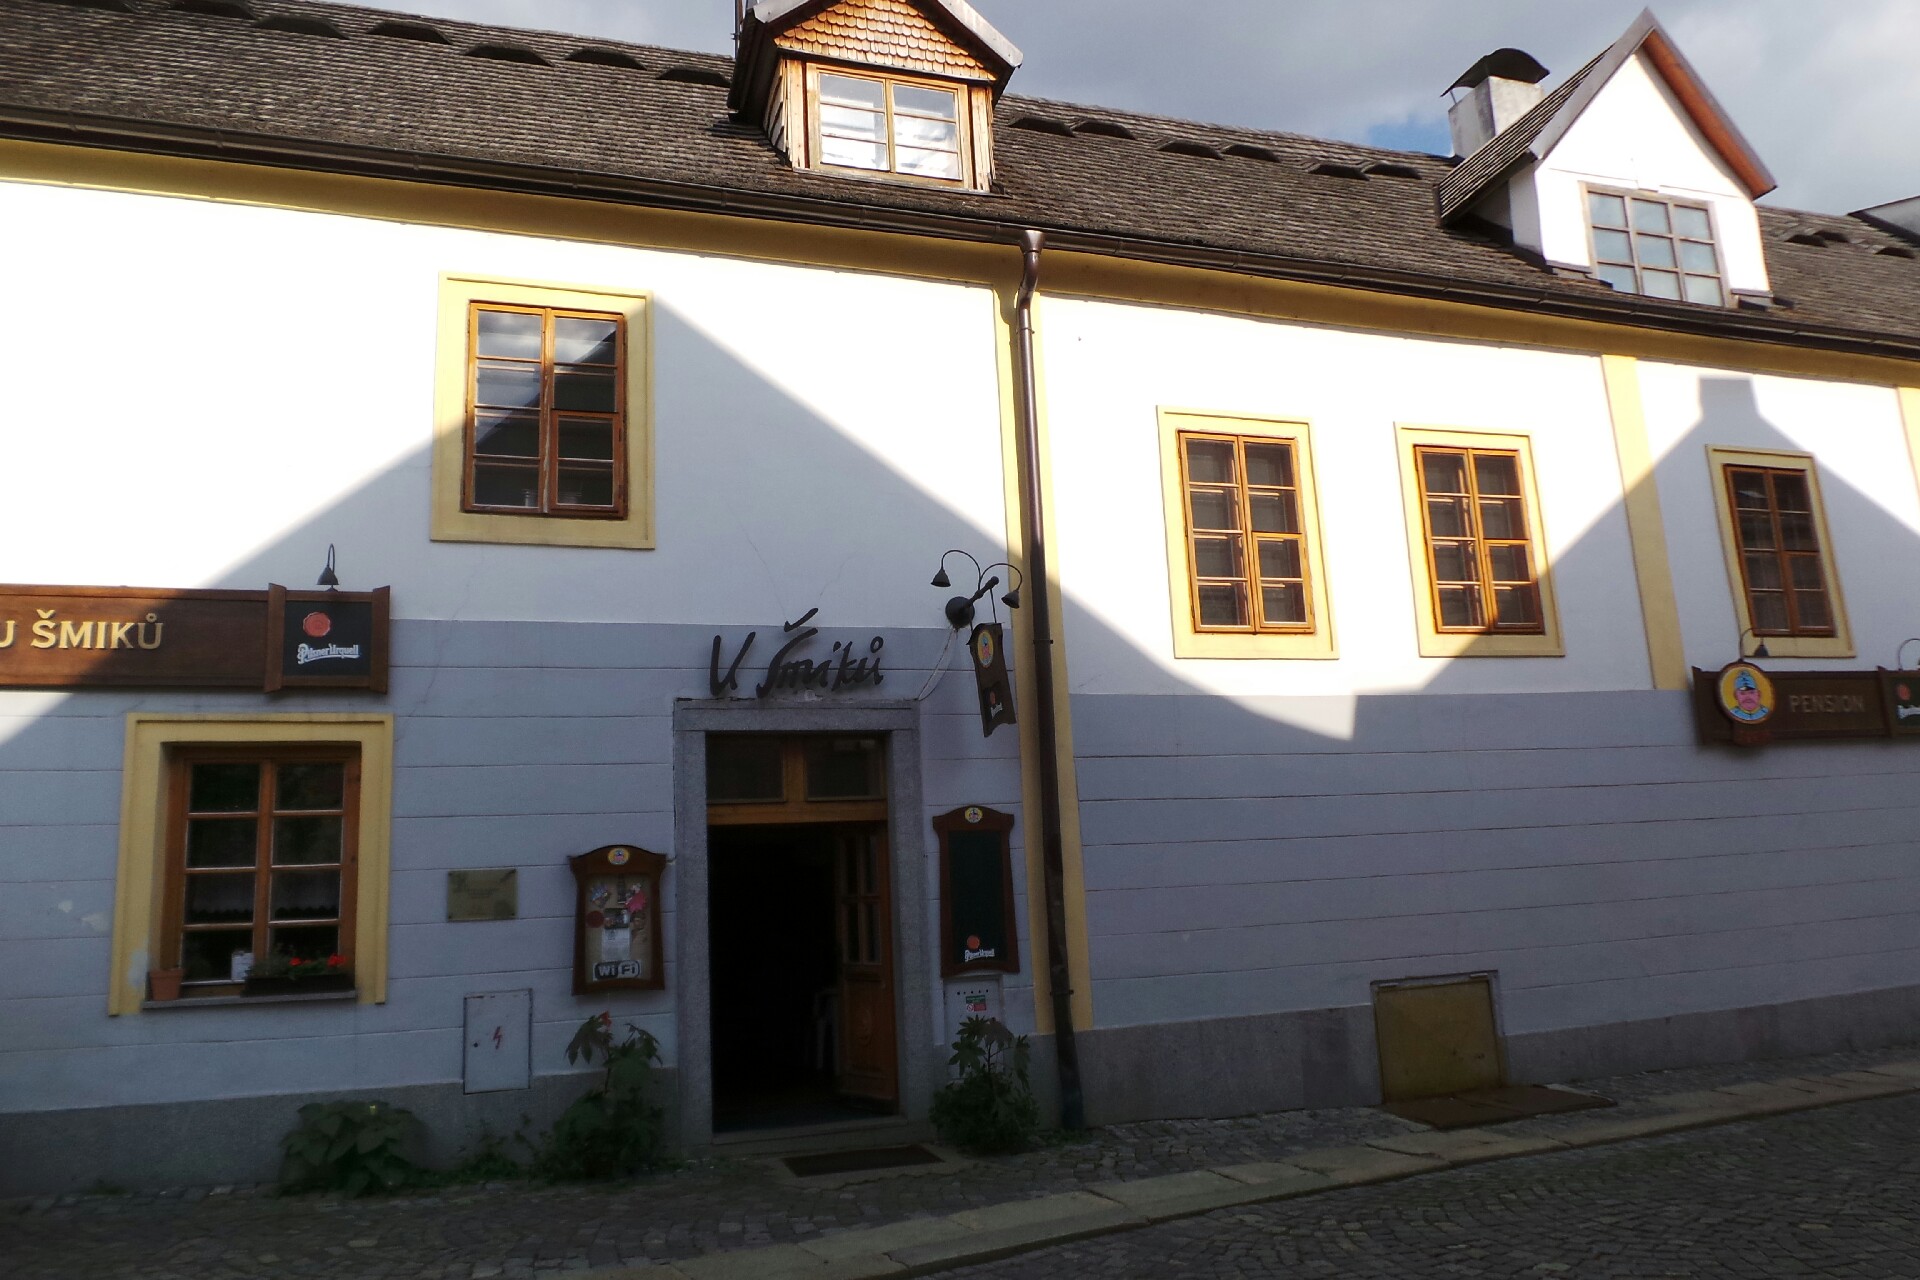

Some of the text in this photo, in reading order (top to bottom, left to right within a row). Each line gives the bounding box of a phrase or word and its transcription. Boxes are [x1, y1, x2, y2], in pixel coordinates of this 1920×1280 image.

[31, 609, 164, 650] ŠMIKŮ
[710, 632, 756, 696] U
[1788, 694, 1866, 713] PENSION
